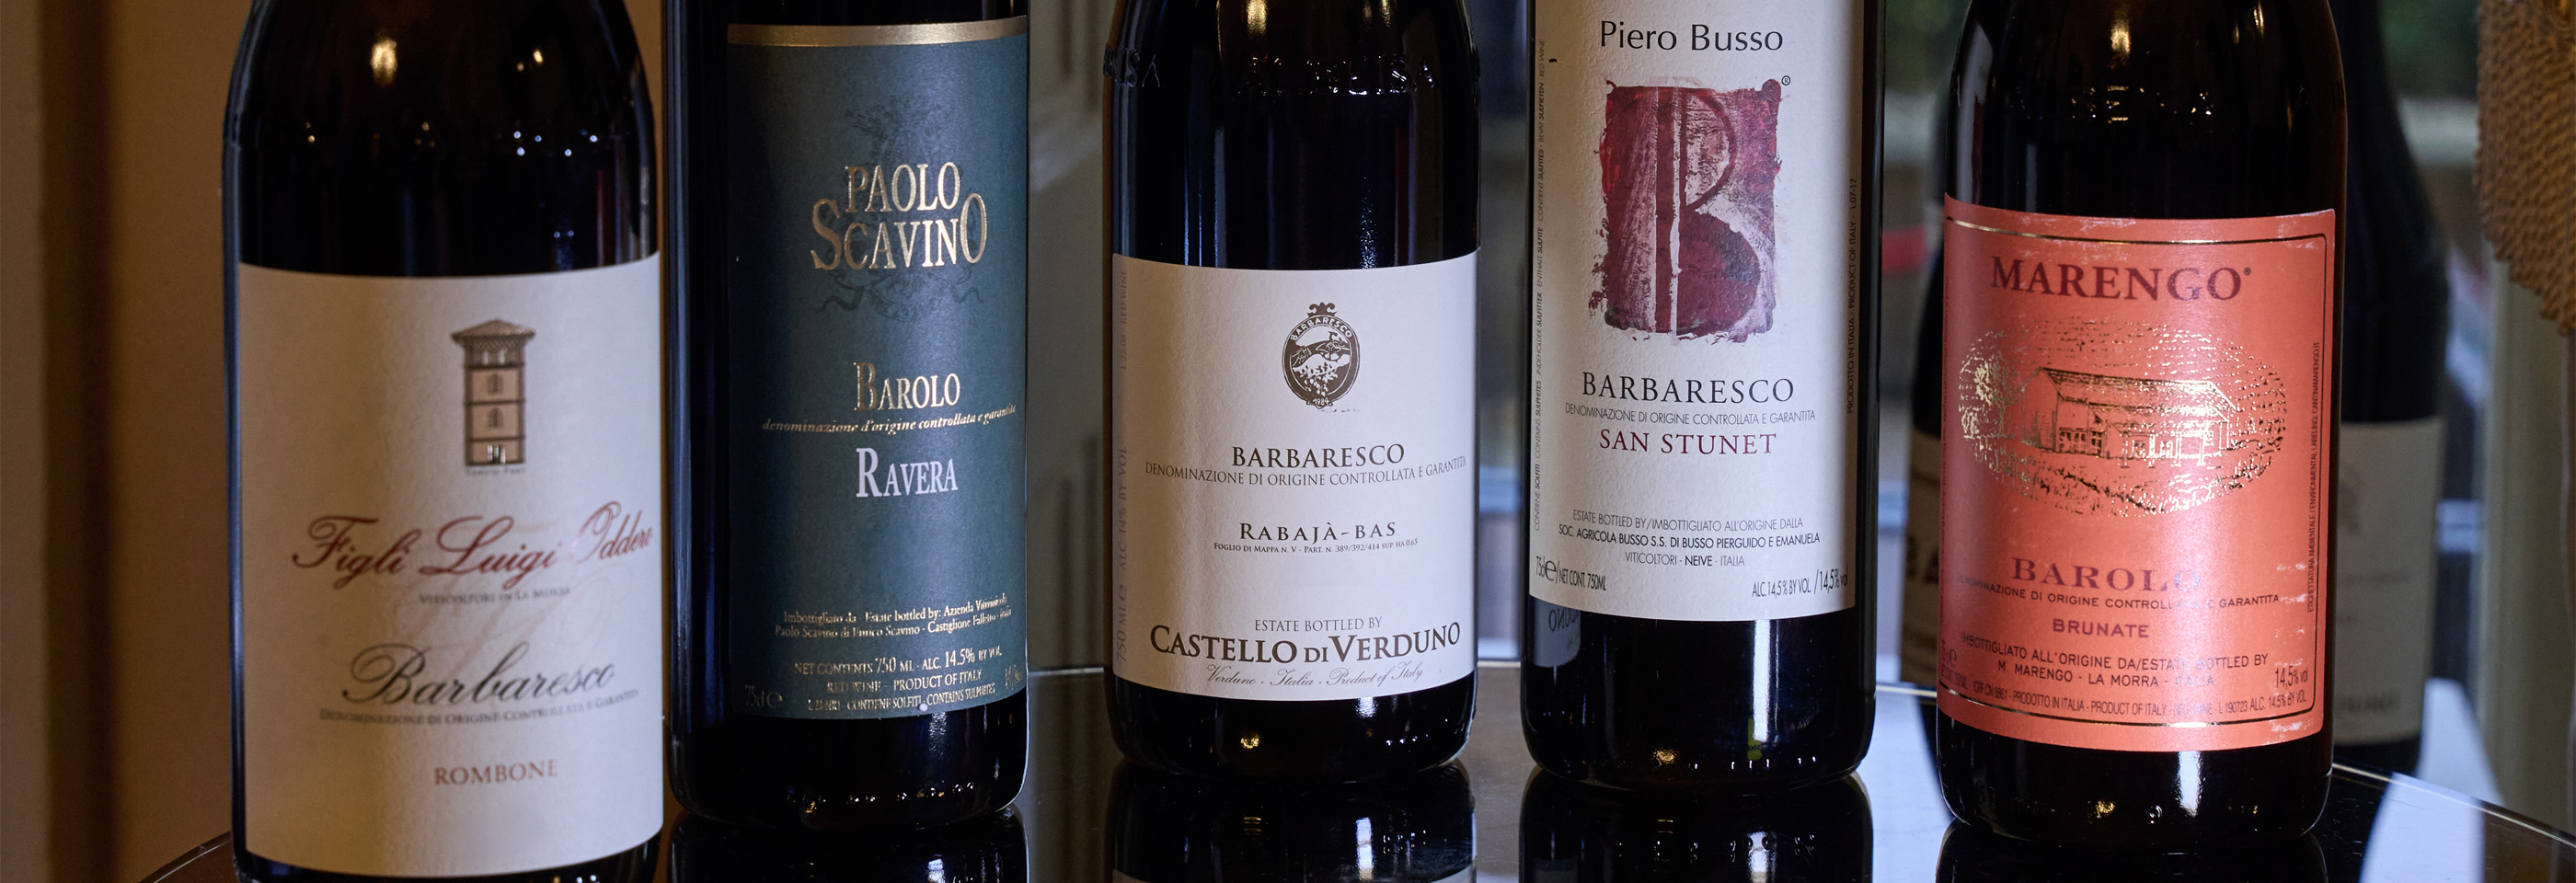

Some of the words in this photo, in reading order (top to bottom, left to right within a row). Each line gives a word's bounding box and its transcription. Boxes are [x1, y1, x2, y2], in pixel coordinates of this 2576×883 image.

[1600, 20, 1677, 51] Piero
[1690, 23, 1783, 52] Busso
[845, 162, 960, 212] PAOLO
[811, 193, 987, 269] SCAVINO
[1849, 247, 1856, 260] OF
[1990, 256, 2242, 301] MARENGO
[1291, 317, 1352, 340] BARBARESCO
[1847, 346, 1855, 357] IN
[854, 361, 960, 411] BAROLO
[1581, 372, 1794, 404] BARBARESCO
[762, 419, 857, 432] denominazione
[861, 419, 915, 435] d'origine
[918, 413, 975, 430] controllata
[978, 414, 983, 422] e
[1565, 402, 1636, 422] DENOMINAZIONE
[1639, 412, 1647, 422] DI
[1650, 411, 1690, 425] ORIGINE
[1693, 412, 1759, 425] CONTROLLATA
[1762, 413, 1767, 424] E
[1771, 409, 1816, 424] GARANTITA
[1599, 429, 1650, 453] SAN
[1661, 433, 1777, 454] STUNET
[1231, 443, 1405, 468] BARBARESCO
[856, 447, 959, 498] RAVERA
[1145, 461, 1245, 485] DENOMINAZIONE
[1248, 474, 1263, 486] DI
[1267, 474, 1326, 487] ORIGINE
[1329, 467, 1415, 486] CONTROLLATA
[1418, 466, 1424, 478] E
[1425, 455, 1466, 476] GARANTITA
[1573, 509, 1596, 523] ESTATE
[1599, 513, 1632, 528] BOTTLED
[1724, 519, 1777, 532] ALL'ORIGINE
[1779, 517, 1803, 530] DALLA
[1214, 542, 1241, 552] FOGLIO
[1336, 543, 1380, 553] 389/392/414
[1396, 540, 1405, 548] HA
[1558, 523, 1574, 537] SOC.
[1576, 528, 1616, 544] AGRICOLA
[1618, 533, 1649, 546] BUSSO
[1650, 535, 1667, 547] S.S.
[1670, 537, 1679, 548] DI
[1682, 537, 1714, 549] BUSSO
[1716, 536, 1765, 549] PIERGUIDO
[1768, 536, 1773, 547] E
[1776, 533, 1820, 547] EMANUELA
[292, 515, 421, 591] Figli
[420, 515, 560, 591] Luigi
[1625, 551, 1677, 566] VITICOLTORI
[1685, 556, 1713, 566] NEIVE
[1720, 555, 1745, 567] ITALIA
[1789, 579, 1798, 594] BY
[1799, 578, 1811, 593] VOL
[2011, 556, 2201, 591] BAROLO
[894, 606, 926, 621] bottled
[928, 607, 941, 621] by:
[944, 601, 973, 616] Azienda
[2031, 591, 2041, 601] DI
[2048, 593, 2099, 607] ORIGINE
[2105, 598, 2199, 609] CONTROLLATA
[2219, 594, 2279, 608] GARANTITA
[885, 625, 920, 636] Scavino
[927, 619, 971, 634] Castiglione
[1254, 618, 1300, 632] ESTATE
[1305, 618, 1364, 632] BOTTLED
[1368, 616, 1383, 628] BY
[2053, 618, 2149, 637] BRUNATE
[1150, 625, 1297, 664] CASTELLO
[1304, 646, 1328, 663] DI
[1328, 621, 1461, 662] VERDUNO
[1961, 632, 2027, 659] IMBOTTIGLIATO
[2031, 649, 2111, 669] ALL'ORIGINE
[2196, 656, 2248, 670] BOTTLED
[2254, 654, 2268, 666] BY
[795, 662, 815, 674] NET
[875, 657, 897, 673] 750
[900, 660, 914, 671] ML
[922, 658, 941, 671] ALC.
[945, 648, 975, 668] 14.5%
[979, 649, 988, 661] BY
[1206, 664, 1256, 686] Verduno
[1270, 668, 1314, 687] Italia
[1327, 665, 1375, 686] Product
[1376, 666, 1388, 687] of
[1391, 660, 1423, 682] Italy
[1998, 659, 2009, 673] M.
[2015, 663, 2073, 682] MARENGO
[2088, 673, 2104, 684] LA
[2110, 675, 2158, 687] MORRA
[342, 643, 615, 705] Barbaresco
[893, 675, 942, 691] PRODUCT
[945, 673, 958, 686] OF
[960, 669, 982, 684] ITALY
[2275, 667, 2299, 690] 14,5%
[2300, 666, 2308, 682] vol
[926, 690, 963, 705] CONTAINS
[2053, 697, 2060, 709] IN
[2062, 697, 2085, 711] ITALIA
[2091, 701, 2129, 715] PRODUCT
[2133, 703, 2143, 716] OF
[2145, 703, 2167, 716] ITALY
[2250, 697, 2266, 711] ALC.
[444, 710, 500, 724] ORIGINE
[434, 759, 558, 786] ROMBONE
